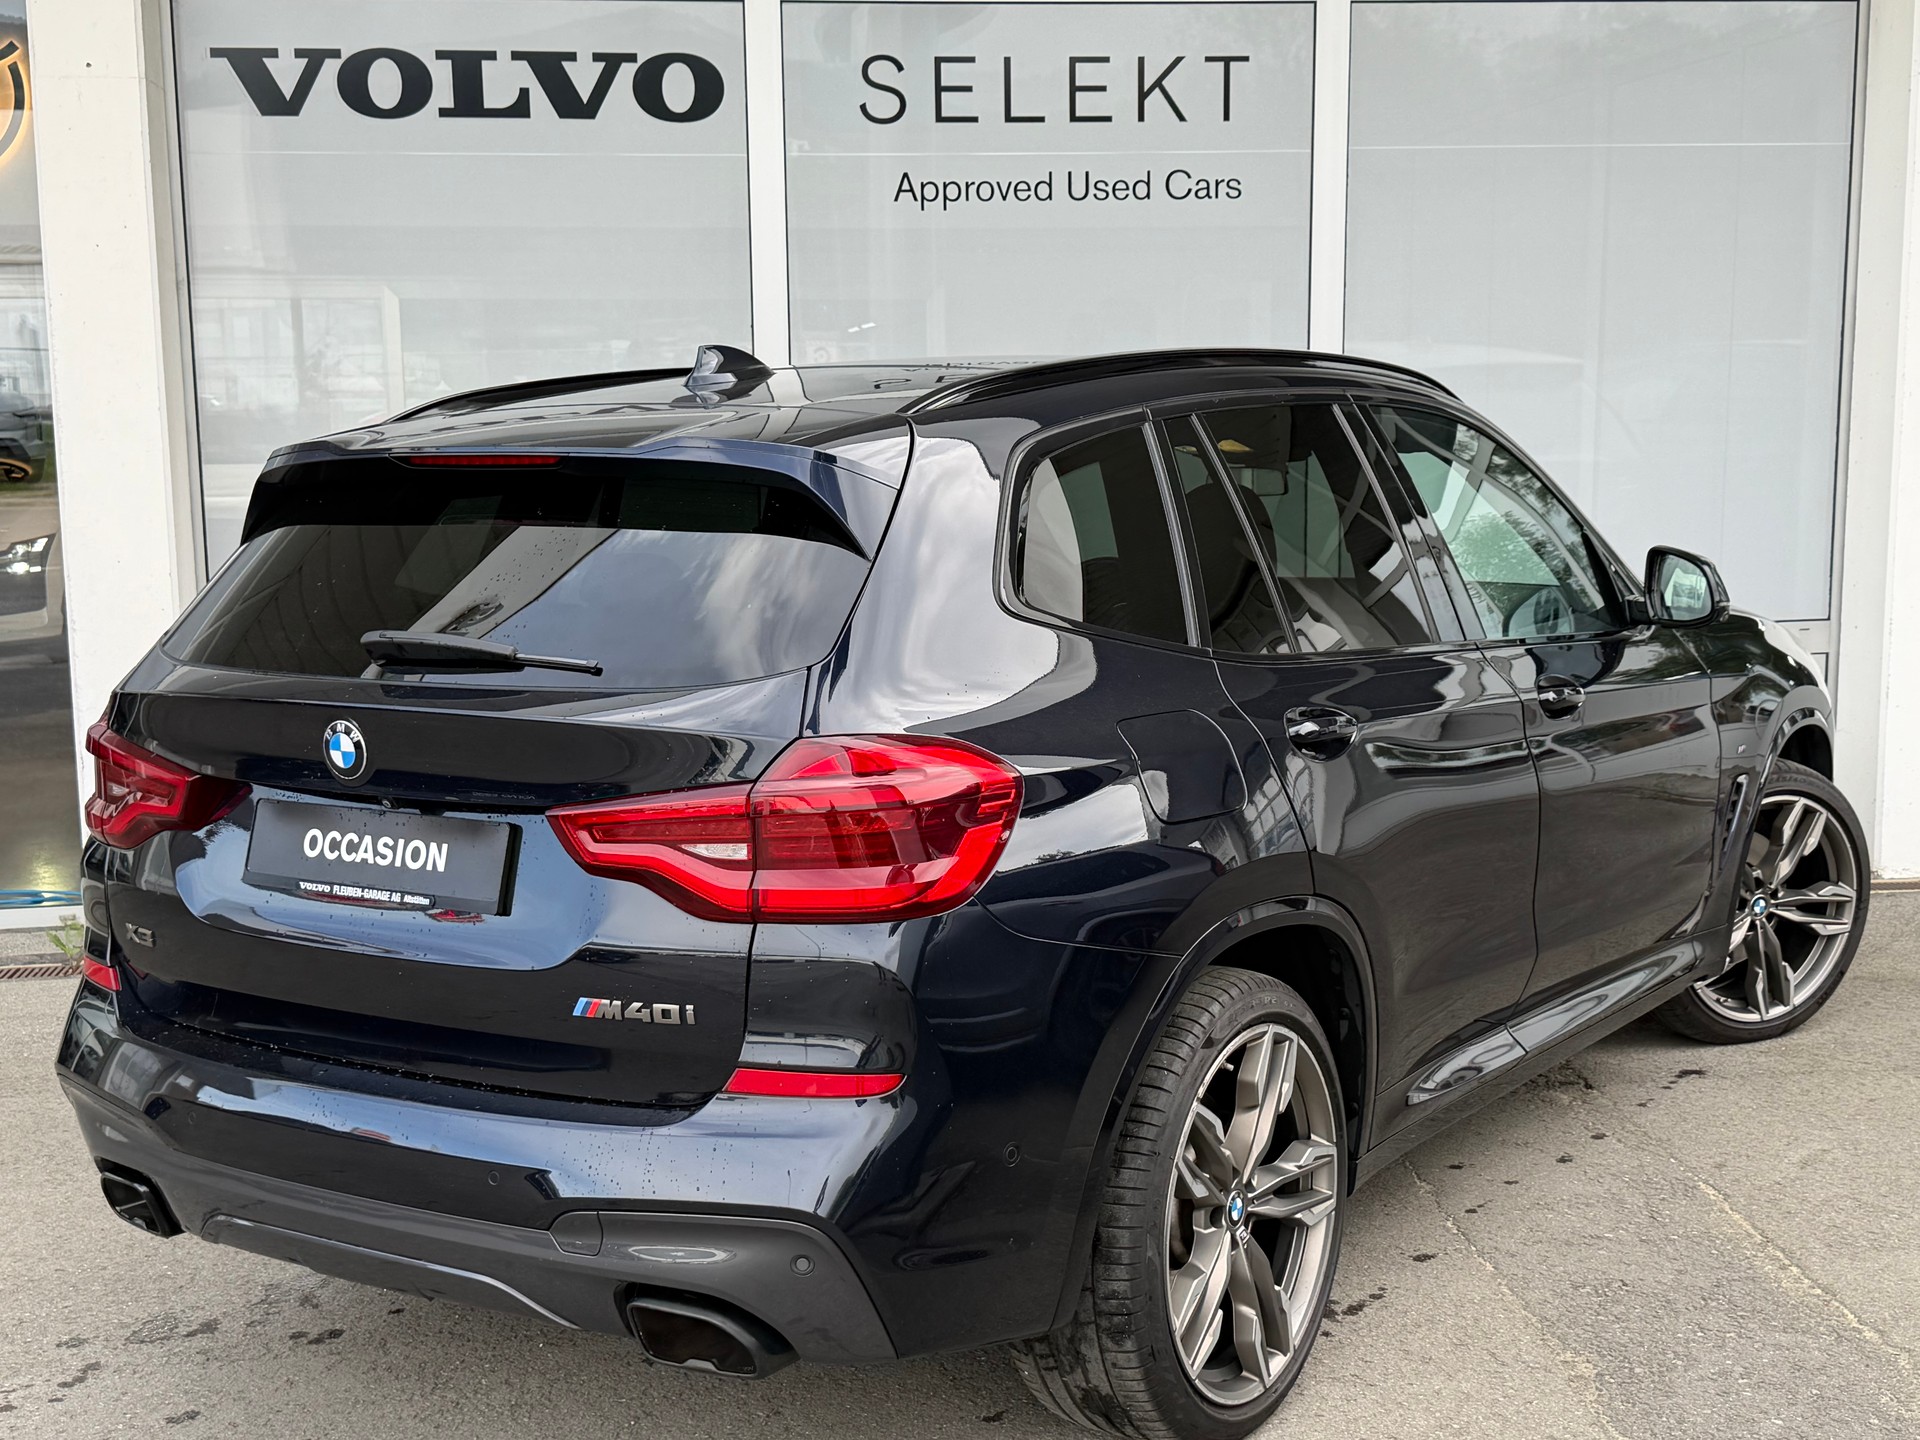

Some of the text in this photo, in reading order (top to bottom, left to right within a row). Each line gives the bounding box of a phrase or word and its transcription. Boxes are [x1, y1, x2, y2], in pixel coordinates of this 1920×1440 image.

[209, 47, 724, 123] VOLVO
[859, 54, 1250, 125] SELEKT
[893, 169, 1242, 211] Approved Used Cars
[325, 722, 361, 743] BMW
[303, 828, 448, 872] OCCASION
[299, 881, 331, 893] VOLVO
[391, 891, 401, 902] AG
[125, 922, 154, 948] X3
[594, 998, 696, 1025] M40i
